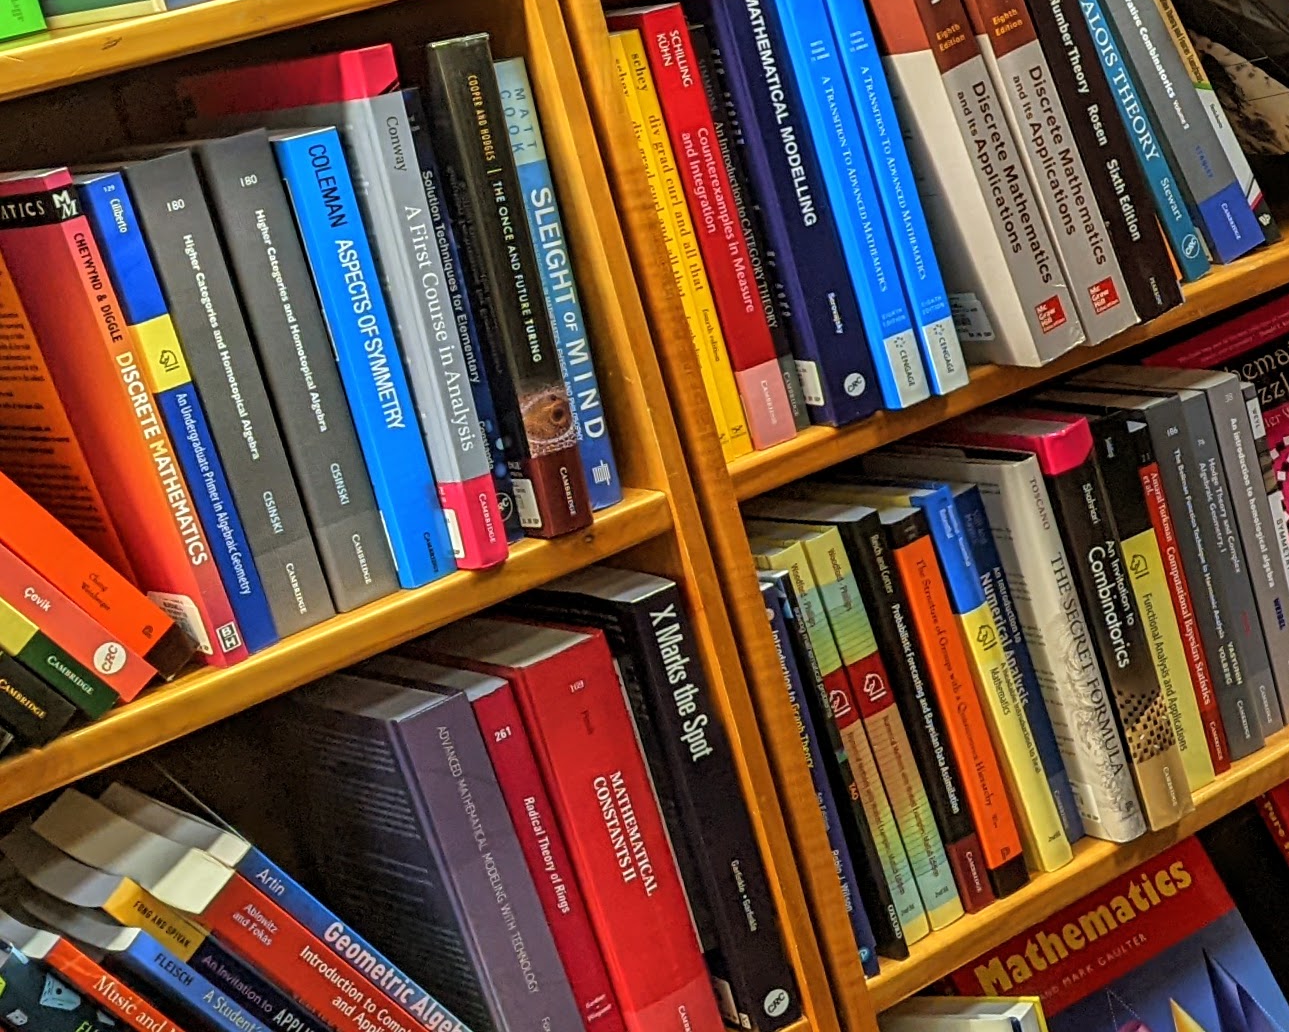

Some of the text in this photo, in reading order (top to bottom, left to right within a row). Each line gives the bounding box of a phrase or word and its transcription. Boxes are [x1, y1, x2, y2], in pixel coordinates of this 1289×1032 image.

[656, 32, 675, 67] KÜHN
[667, 28, 694, 88] SCHILLING
[1067, 46, 1090, 94] Theory
[1087, 104, 1108, 147] Rosen
[1112, 66, 1161, 162] THEORY
[308, 144, 348, 228] COLEMAN
[779, 126, 817, 228] MODELLING
[1159, 176, 1183, 221] Stewart
[183, 234, 259, 460] Higher Categories and Homotopical Algebra
[335, 239, 406, 429] ASPECTS OF SYMMETRY
[405, 206, 474, 452] A First Course in Analysis
[531, 187, 605, 439] SLEIGHT OF MIND
[115, 351, 209, 566] DISCRETE MATHEMATICS
[1088, 546, 1130, 669] Combinatorics
[47, 655, 94, 695] CAMBRIDGE
[650, 603, 713, 762] X Marks the Spot
[1050, 551, 1125, 776] THE SECRET FORMULA
[494, 726, 512, 742] 261
[593, 777, 637, 882] CONSTANTS II
[610, 771, 658, 897] MATHEMATICAL
[256, 868, 285, 896] Artin
[972, 858, 1195, 998] Mathematics
[324, 921, 415, 1003] Geometric
